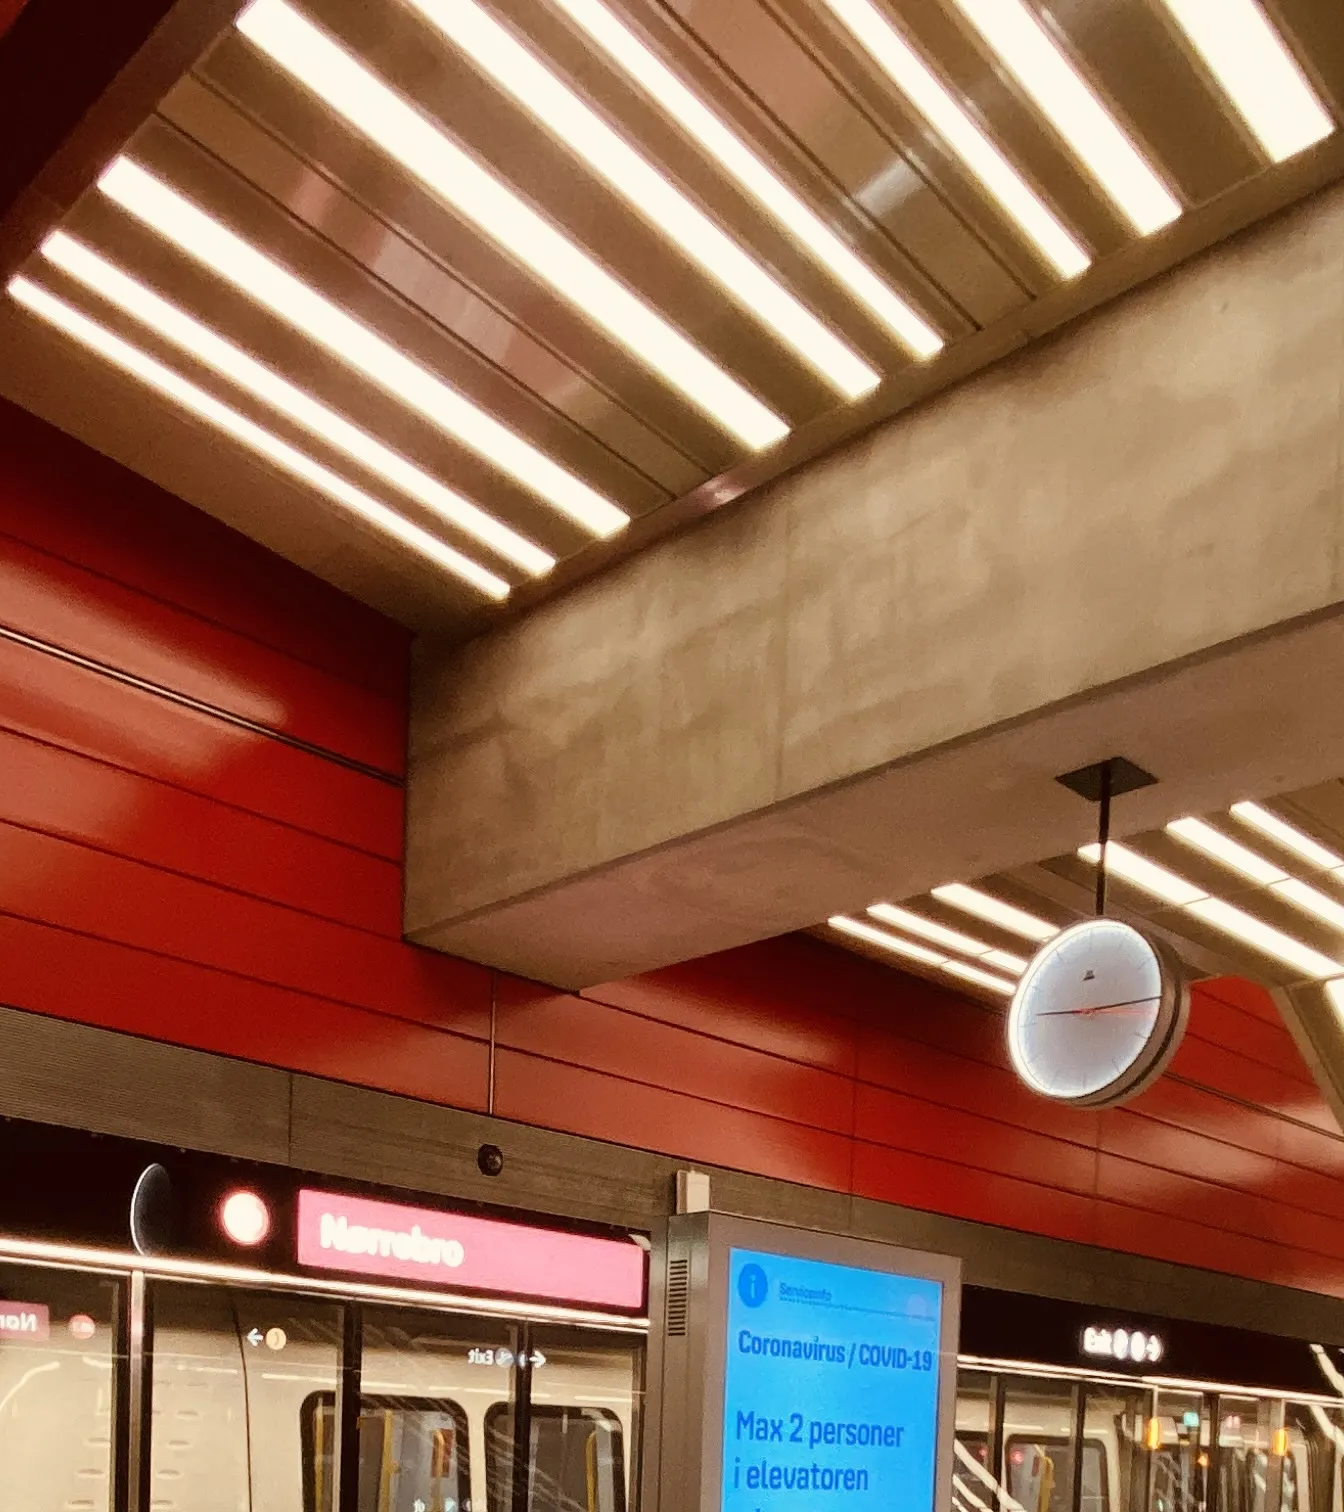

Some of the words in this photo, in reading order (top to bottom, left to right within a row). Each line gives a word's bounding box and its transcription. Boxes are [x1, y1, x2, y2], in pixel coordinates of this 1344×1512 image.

[738, 1329, 846, 1363] Coronavirus
[847, 1343, 857, 1370] /
[859, 1343, 933, 1371] COVID-19
[736, 1409, 784, 1442] Max
[789, 1412, 804, 1443] 2
[809, 1420, 904, 1449] personer
[734, 1456, 741, 1489] i
[746, 1459, 869, 1490] elevatoren
